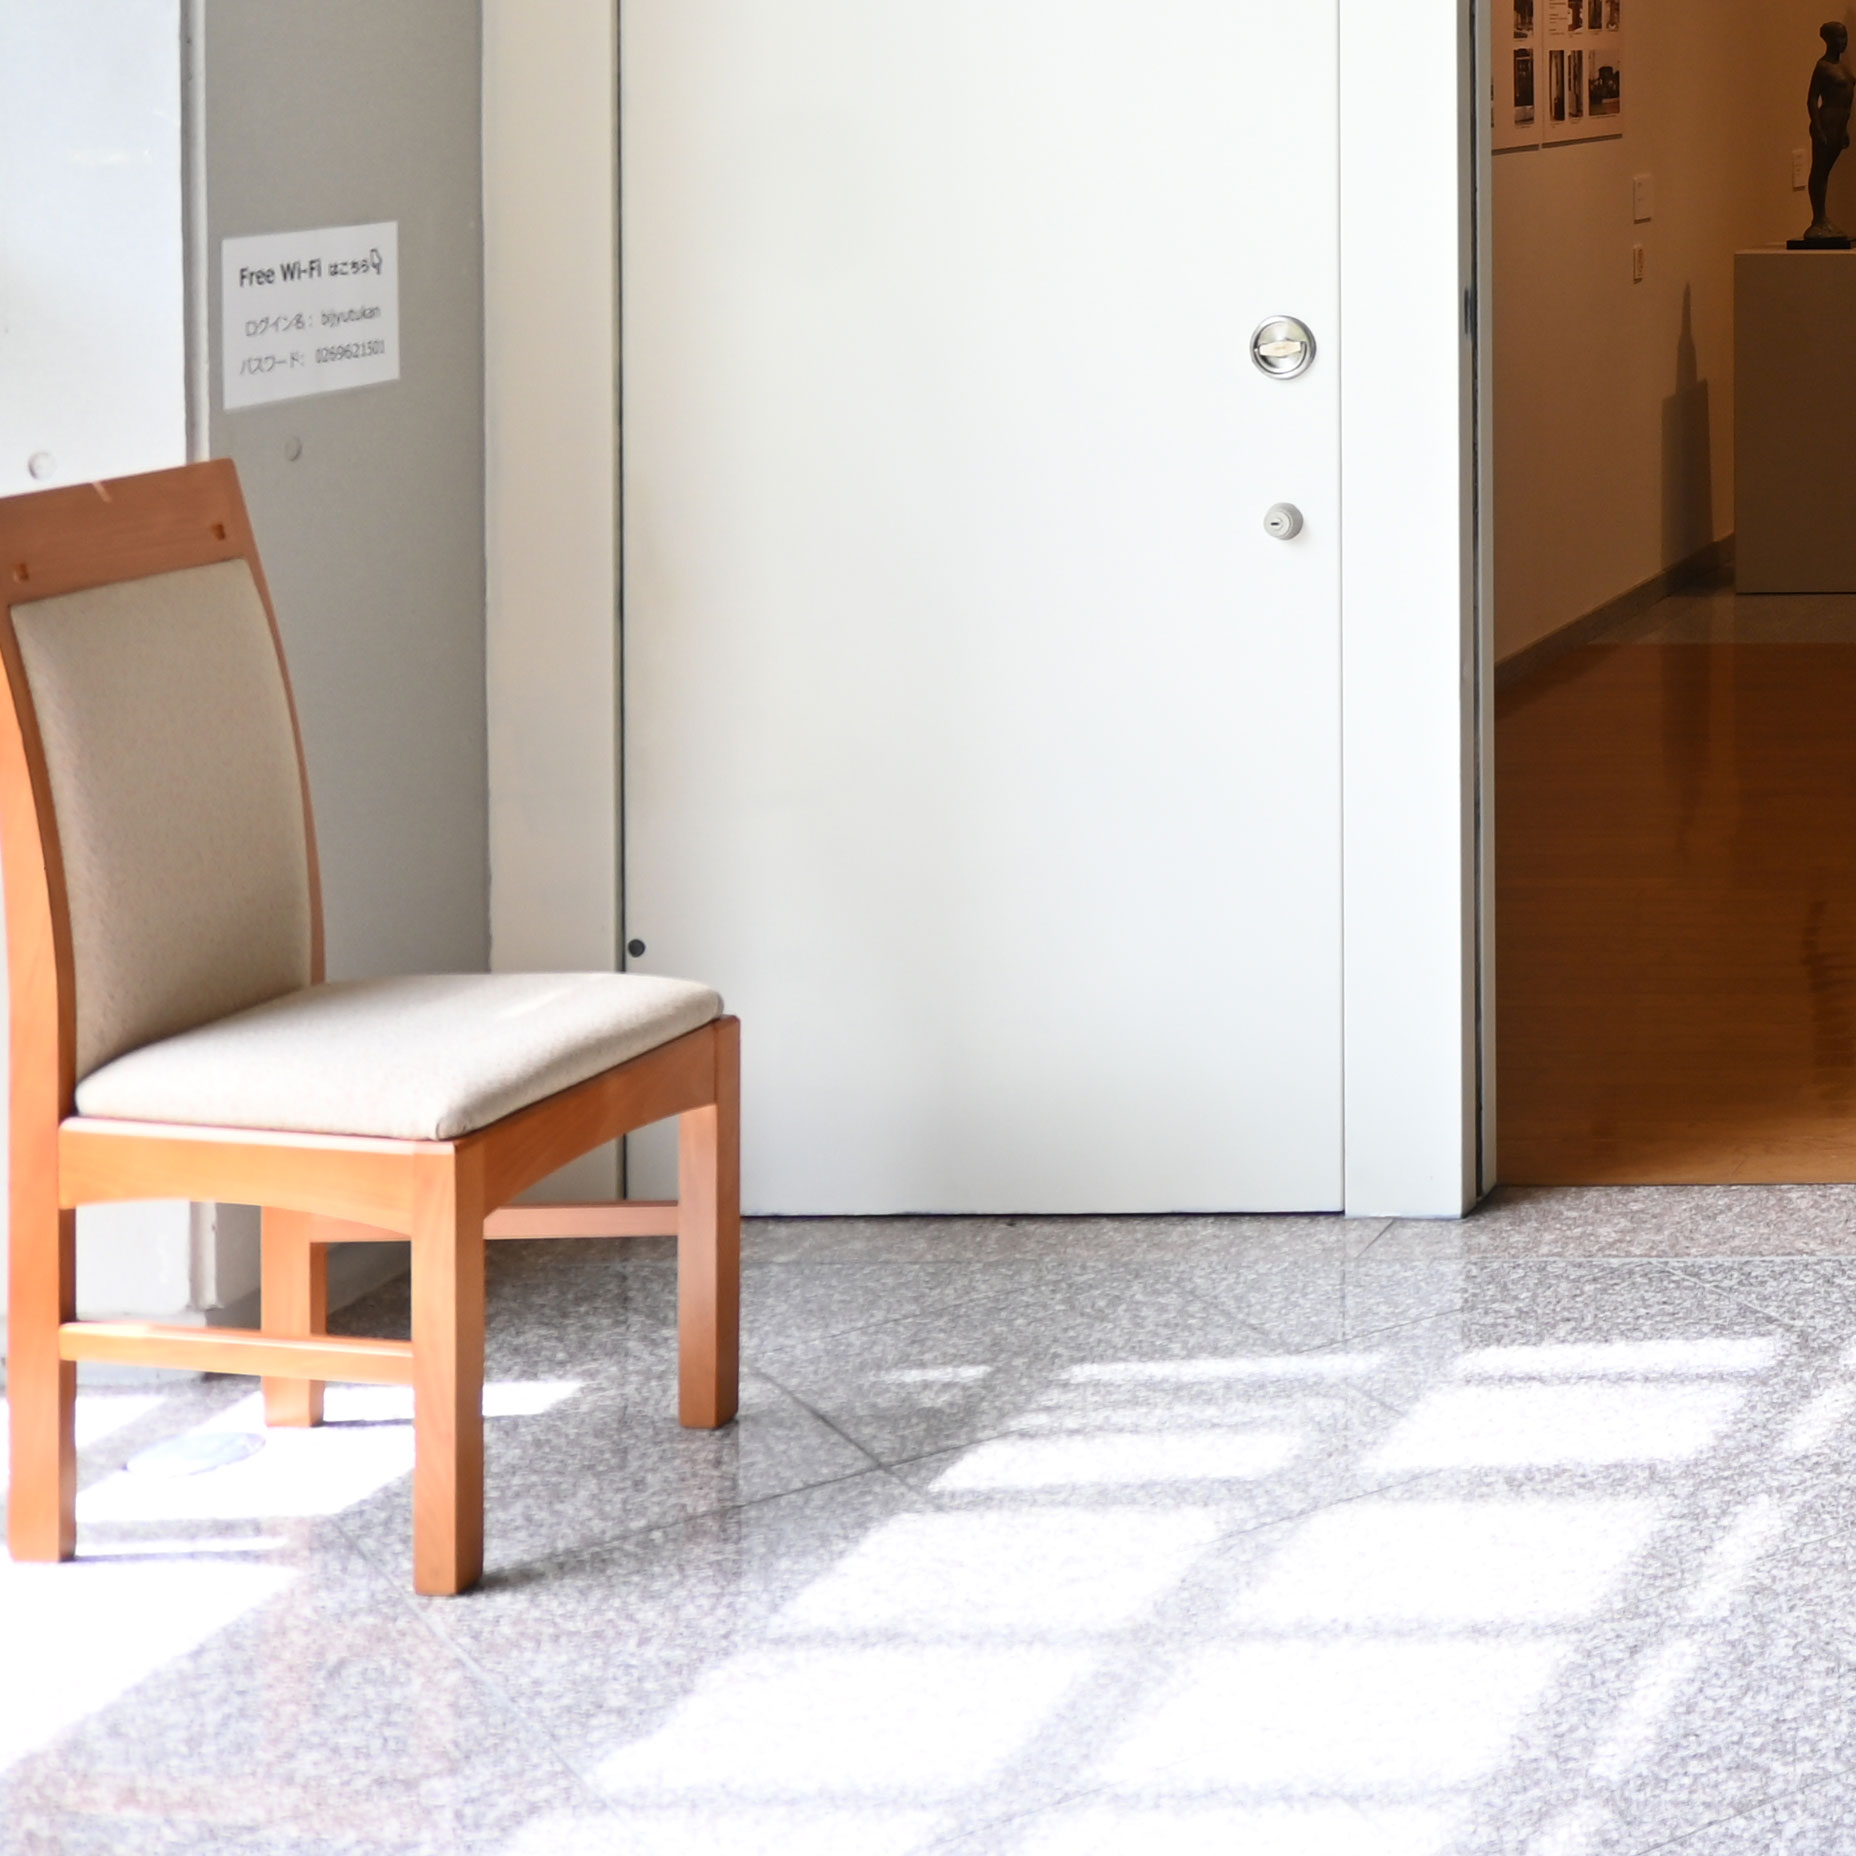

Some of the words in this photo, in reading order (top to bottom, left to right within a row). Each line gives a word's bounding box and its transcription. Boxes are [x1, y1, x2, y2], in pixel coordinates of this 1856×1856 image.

[238, 265, 276, 288] Free
[279, 257, 322, 282] Wi-Fi
[327, 259, 369, 277] はこちら
